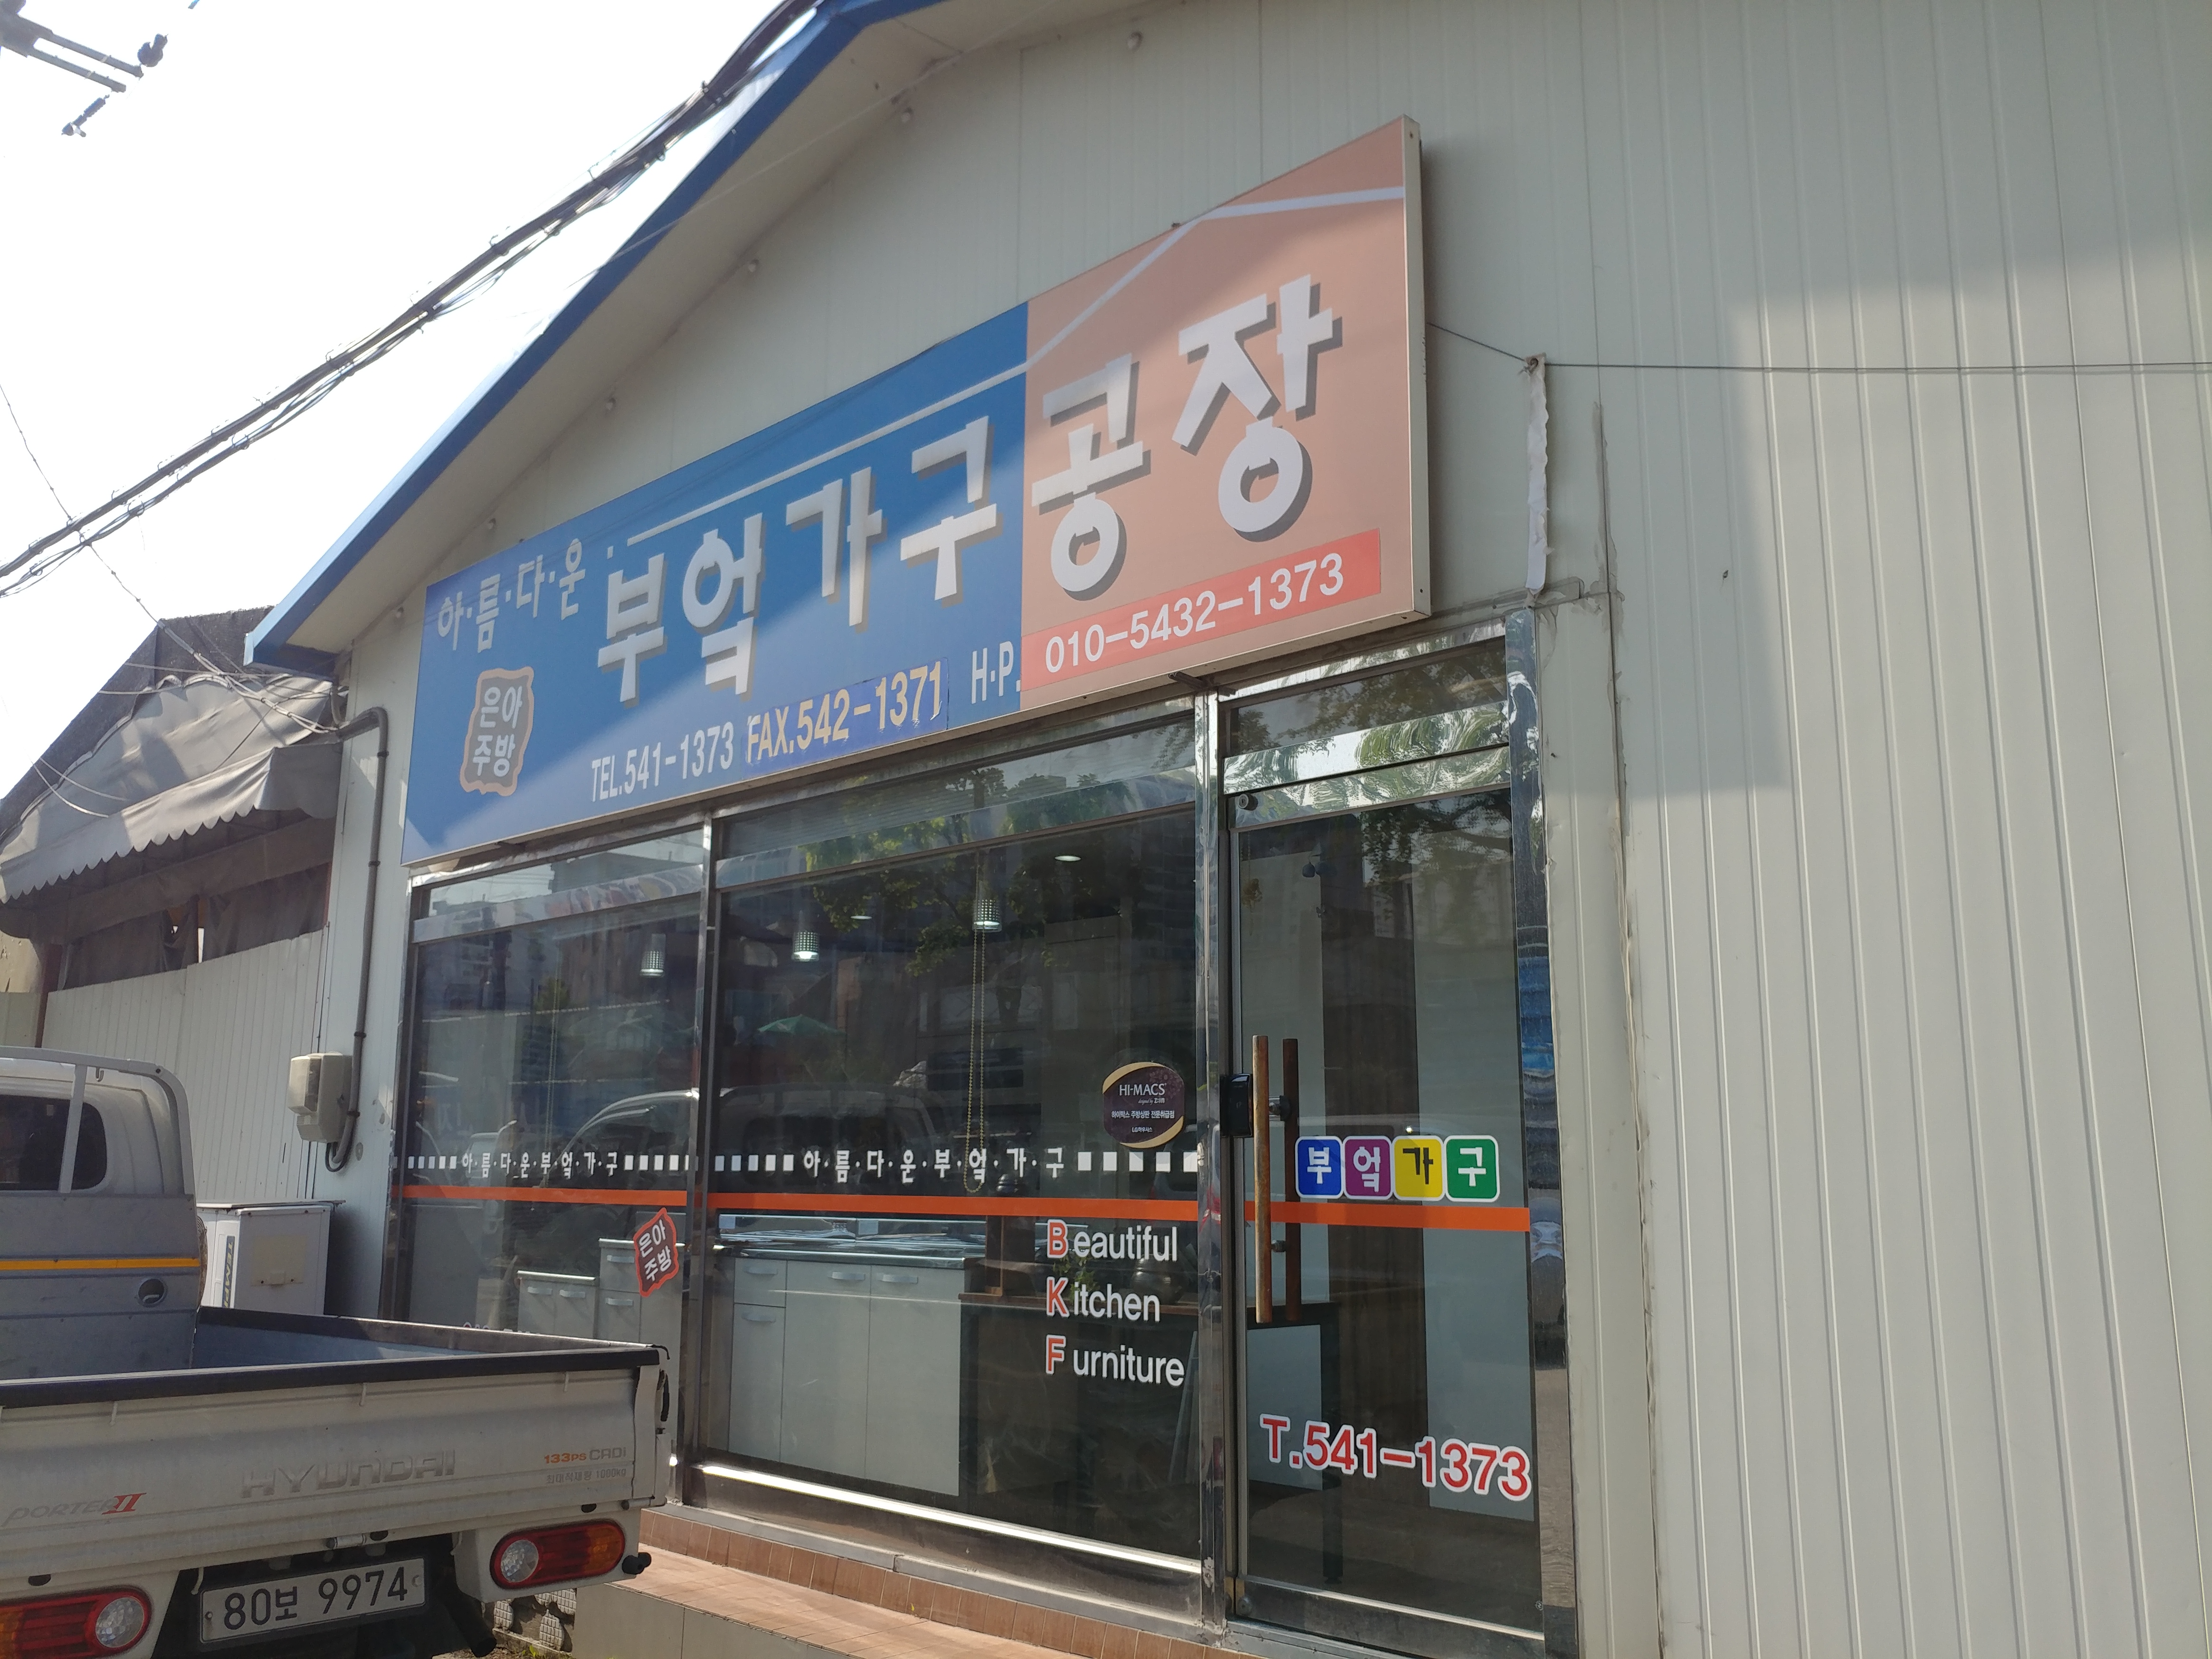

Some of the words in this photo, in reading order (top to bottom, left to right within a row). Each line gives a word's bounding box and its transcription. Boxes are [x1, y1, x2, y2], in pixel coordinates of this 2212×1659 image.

[1031, 274, 1334, 592] 공장
[1045, 553, 1344, 673] 010-5432-1373
[480, 686, 522, 729] 은아
[473, 734, 515, 777] 주방
[1111, 1110, 1130, 1119] 하이막스
[1131, 1110, 1150, 1119] 주방상판
[639, 1219, 666, 1258] 은아
[644, 1245, 672, 1281] 주방
[241, 1449, 456, 1498] HYUNDAI
[546, 1470, 592, 1484] 최대적재량
[223, 1585, 297, 1630] 80보
[318, 1566, 408, 1614] 9974
